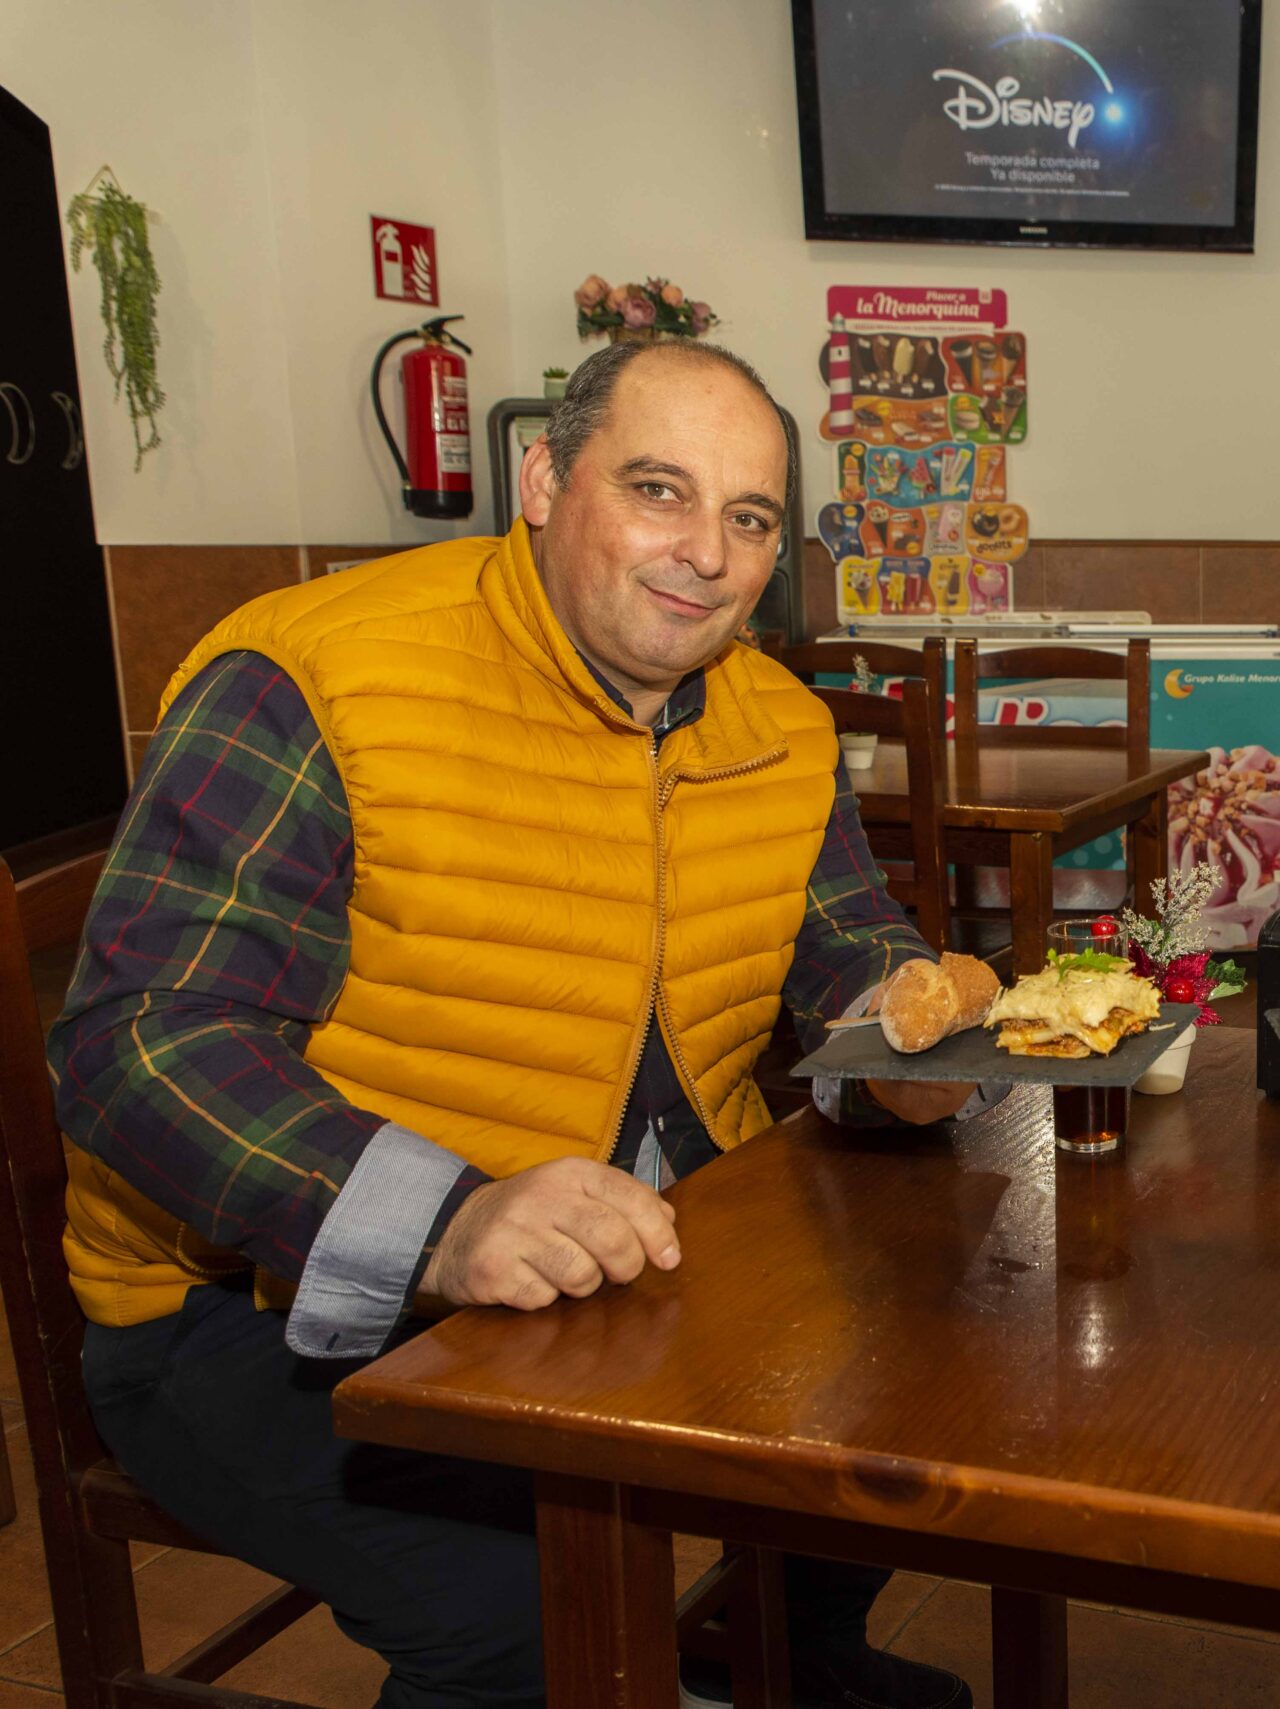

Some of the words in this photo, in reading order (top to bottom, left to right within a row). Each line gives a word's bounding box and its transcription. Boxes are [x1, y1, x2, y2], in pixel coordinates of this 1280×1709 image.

[932, 69, 1095, 148] Disney
[965, 152, 1036, 169] Temporada
[1040, 155, 1099, 171] completa
[991, 169, 1006, 180] Ya
[1008, 168, 1075, 183] disponible
[857, 297, 874, 314] la
[873, 291, 981, 319] Menorquina
[1184, 674, 1214, 684] Grupo
[1217, 673, 1245, 683] Kalise
